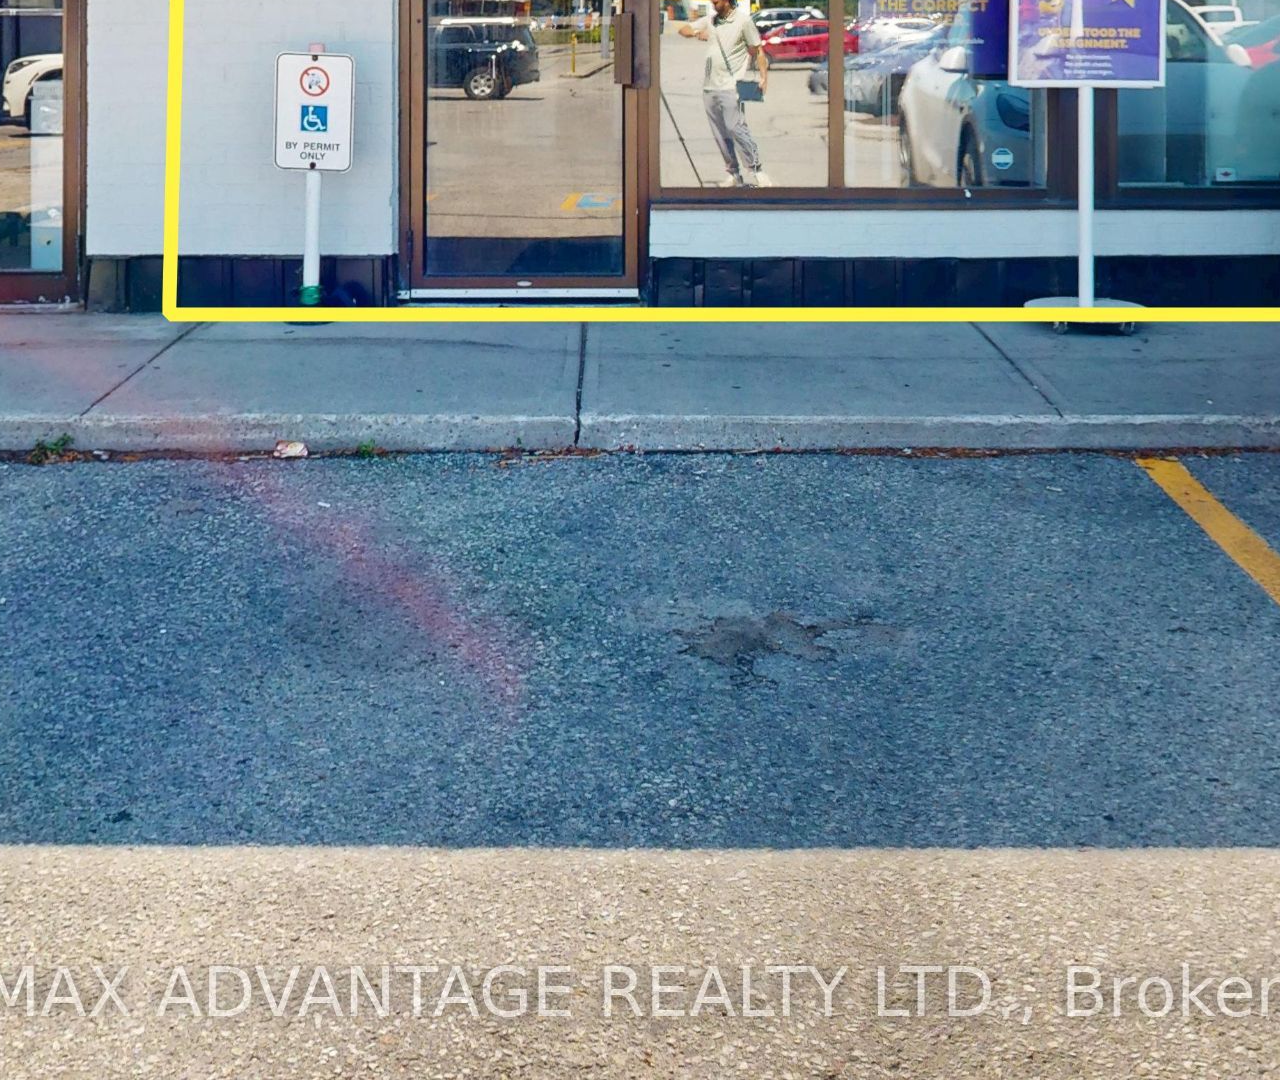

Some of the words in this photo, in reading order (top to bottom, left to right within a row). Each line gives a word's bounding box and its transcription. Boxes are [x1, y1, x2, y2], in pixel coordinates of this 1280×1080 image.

[1117, 27, 1142, 39] THE
[284, 141, 298, 150] BY
[303, 142, 341, 152] PERMIT
[299, 151, 327, 161] ONLY
